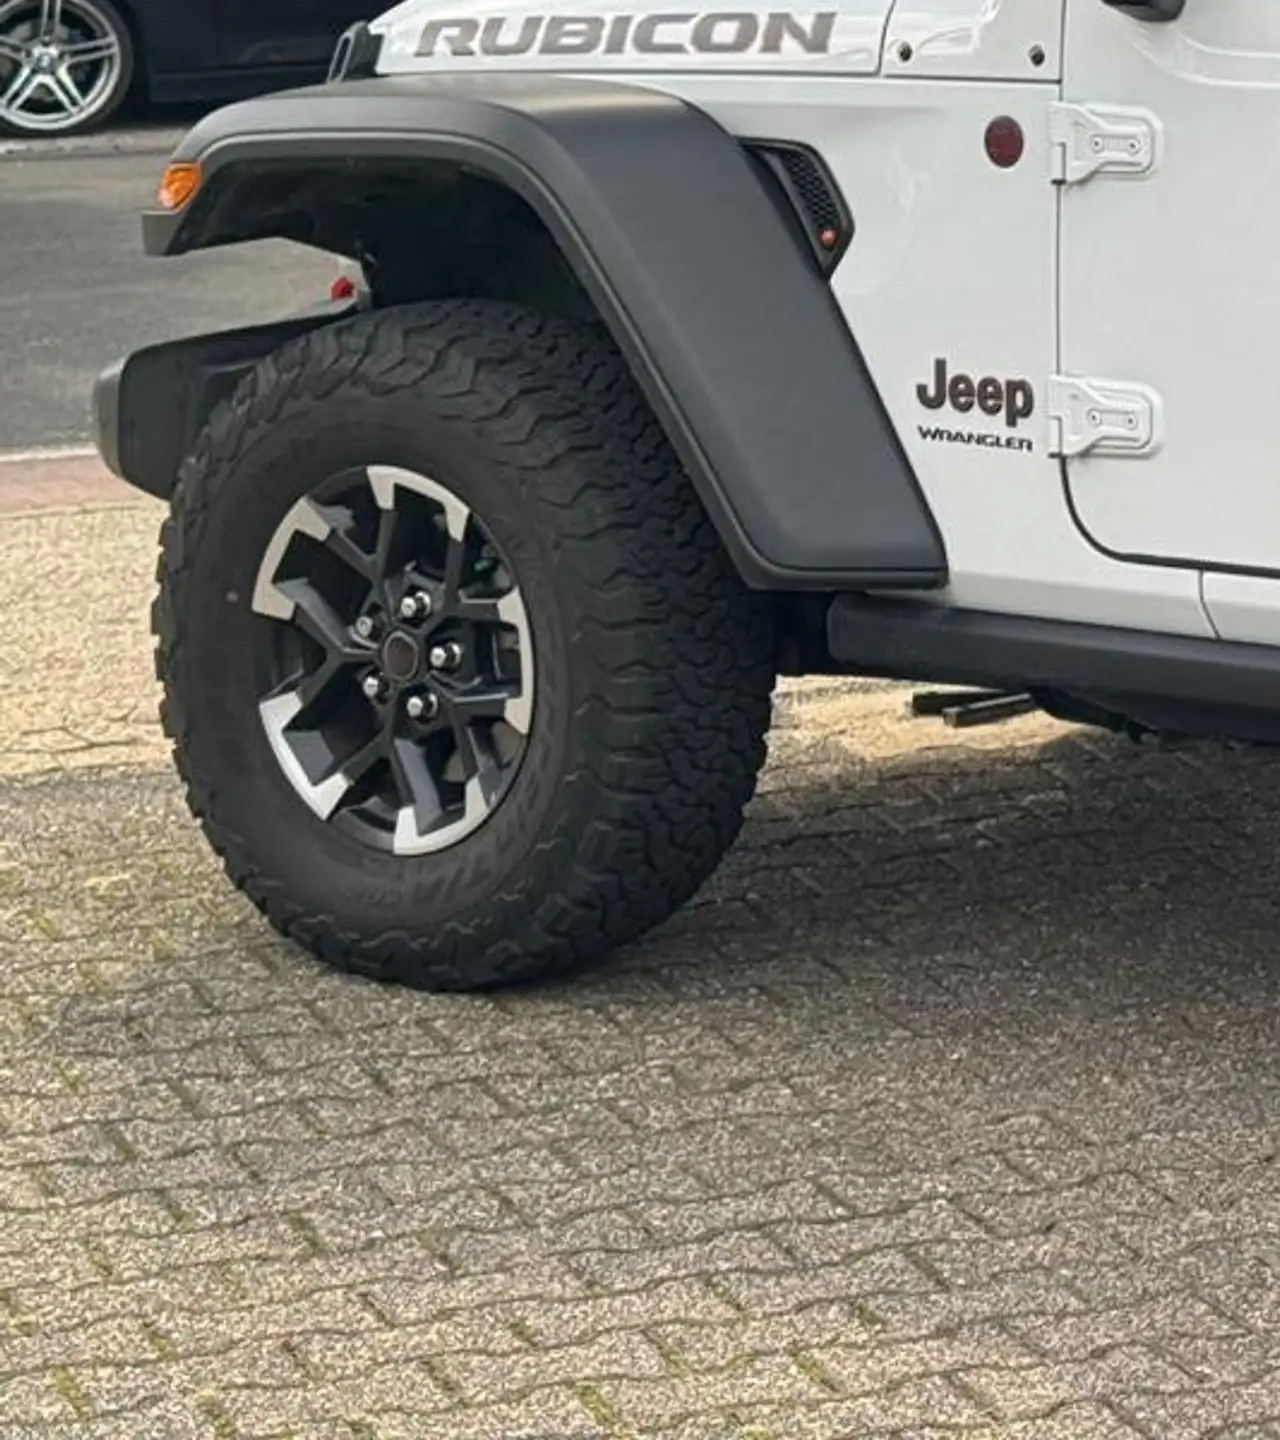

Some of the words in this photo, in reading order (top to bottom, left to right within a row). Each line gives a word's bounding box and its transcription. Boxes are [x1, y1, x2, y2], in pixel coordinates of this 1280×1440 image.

[413, 10, 838, 58] RUBICON
[915, 357, 1035, 428] Jeep
[917, 425, 1034, 452] WRANGLER
